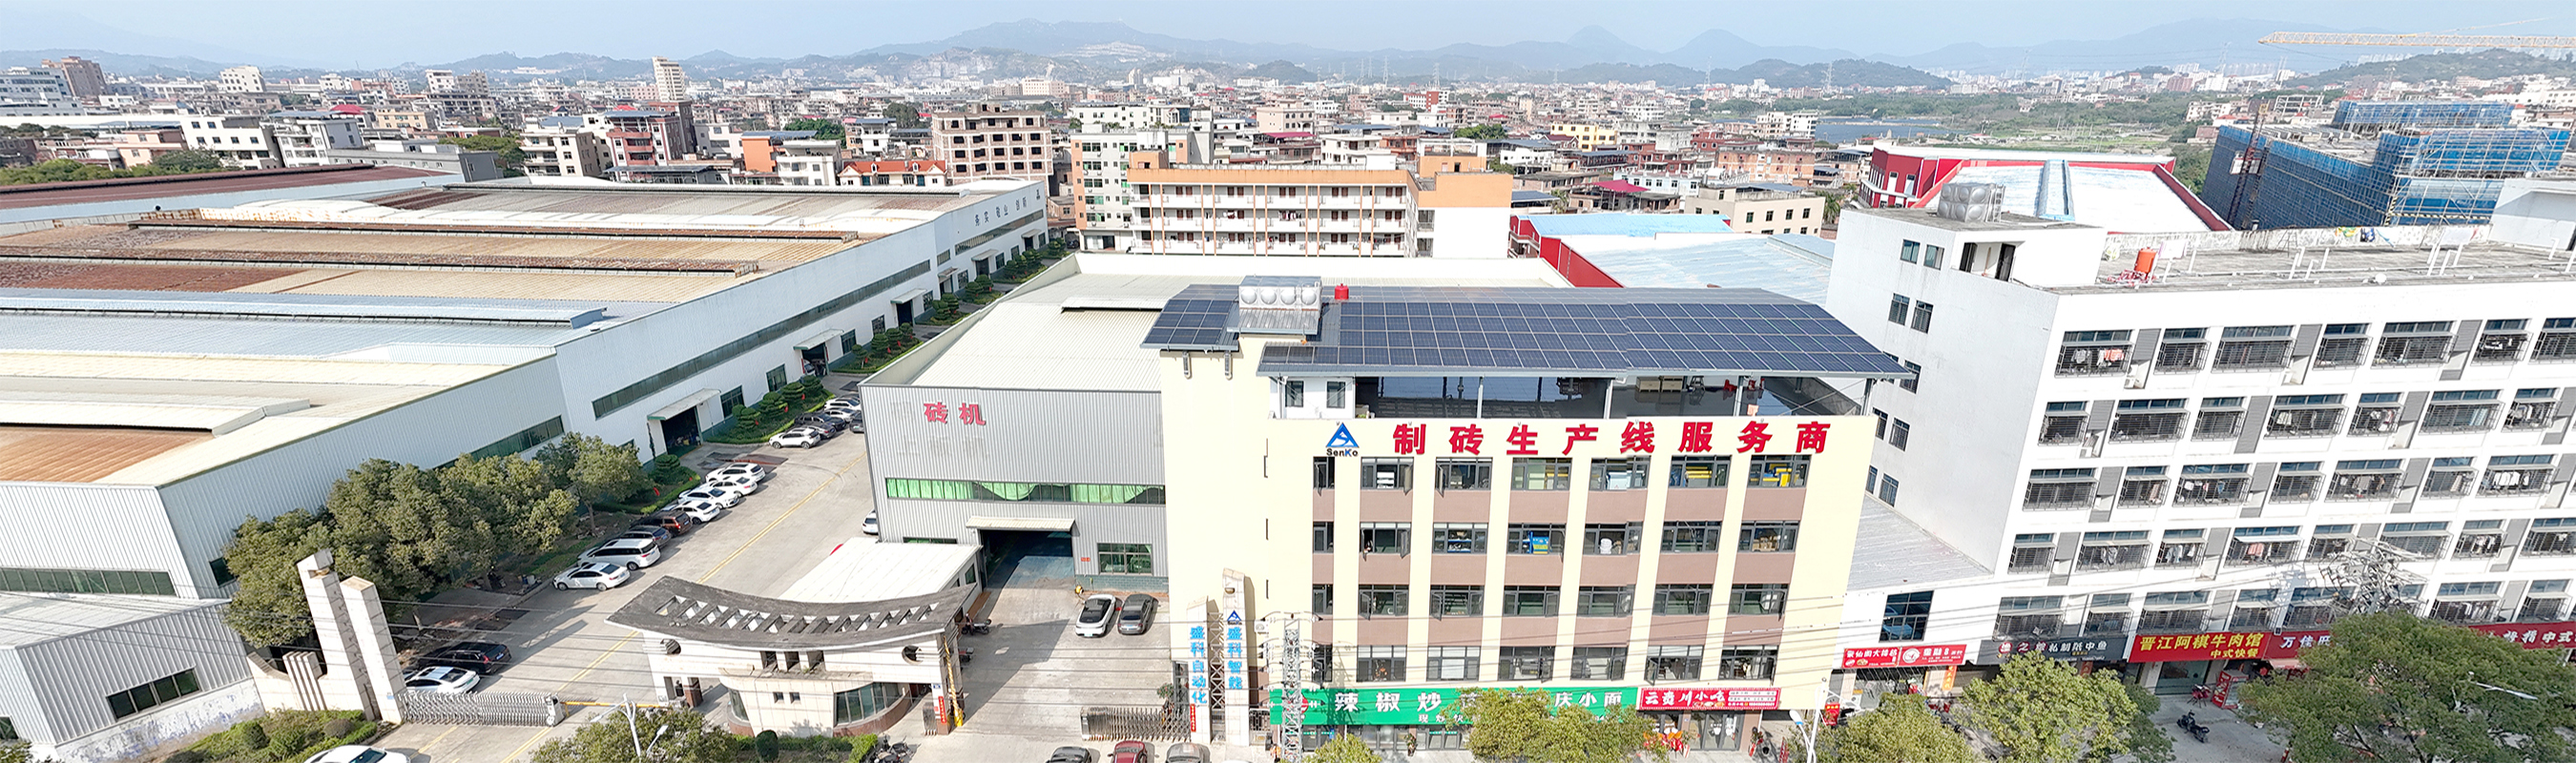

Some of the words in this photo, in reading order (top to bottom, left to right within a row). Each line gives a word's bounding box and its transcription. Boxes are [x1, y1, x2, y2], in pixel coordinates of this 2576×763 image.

[924, 402, 987, 425] 砖机
[1393, 421, 1831, 456] 制砖生产线服务商
[1326, 447, 1359, 457] SenKo
[2140, 633, 2264, 650] 晋江阿棋牛肉馆
[1190, 626, 1207, 704] 盛科自动化
[1227, 627, 1242, 690] 盛科智能
[2211, 649, 2258, 658] 中式快餐
